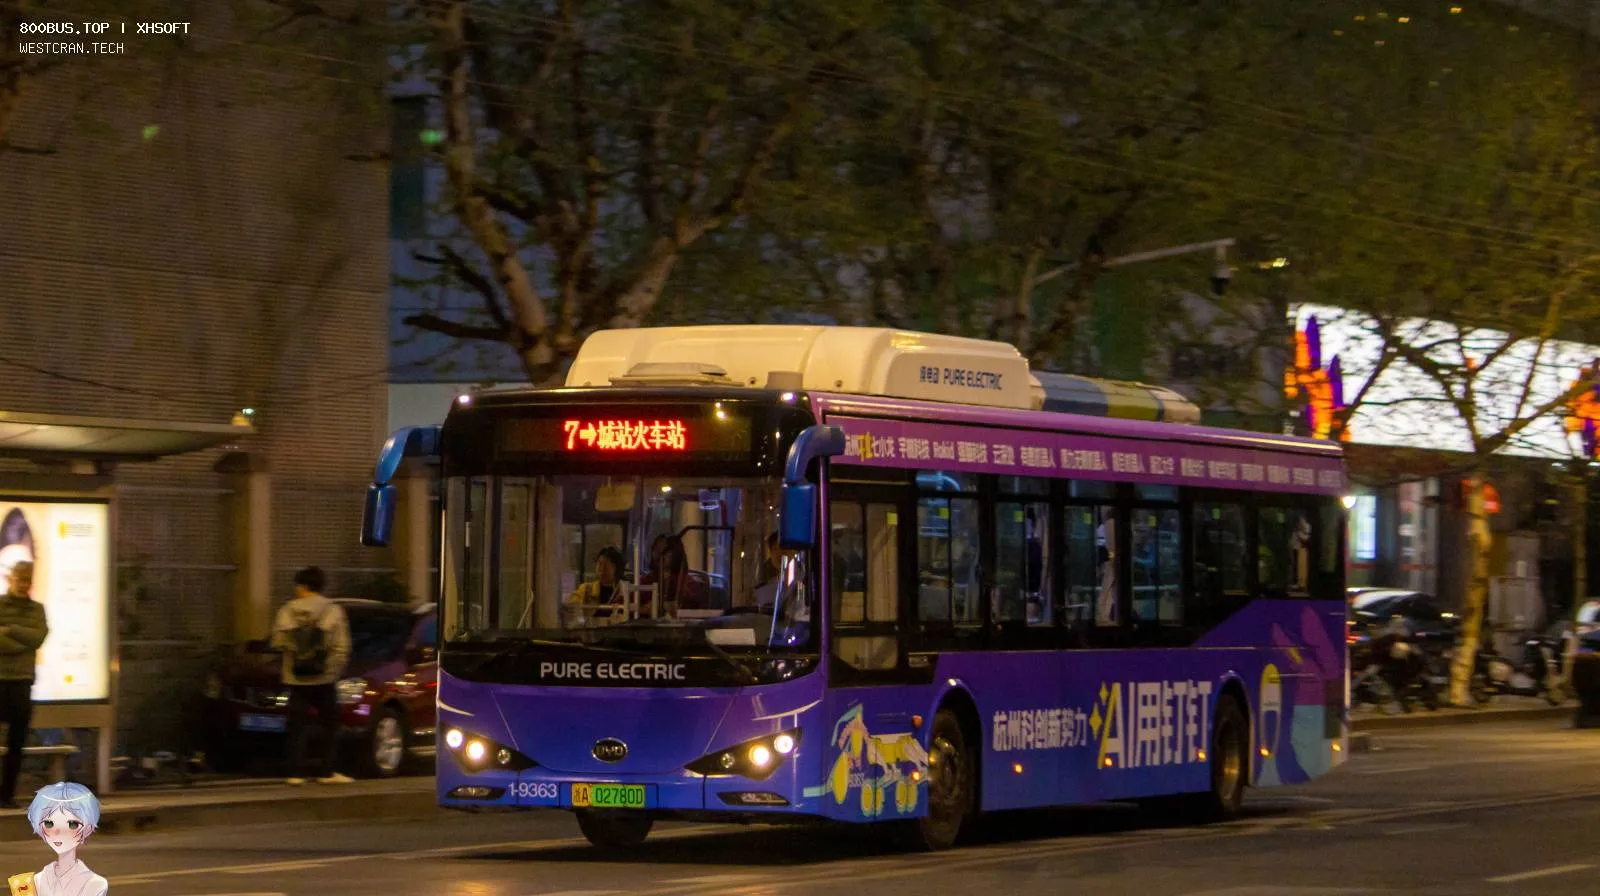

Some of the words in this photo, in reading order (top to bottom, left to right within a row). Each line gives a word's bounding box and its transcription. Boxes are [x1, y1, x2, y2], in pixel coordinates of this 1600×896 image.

[564, 420, 580, 449] 7
[597, 420, 686, 449] 城站火车站
[540, 662, 592, 679] PURE
[596, 663, 686, 680] ELECTRIC
[508, 781, 557, 798] 1-9363
